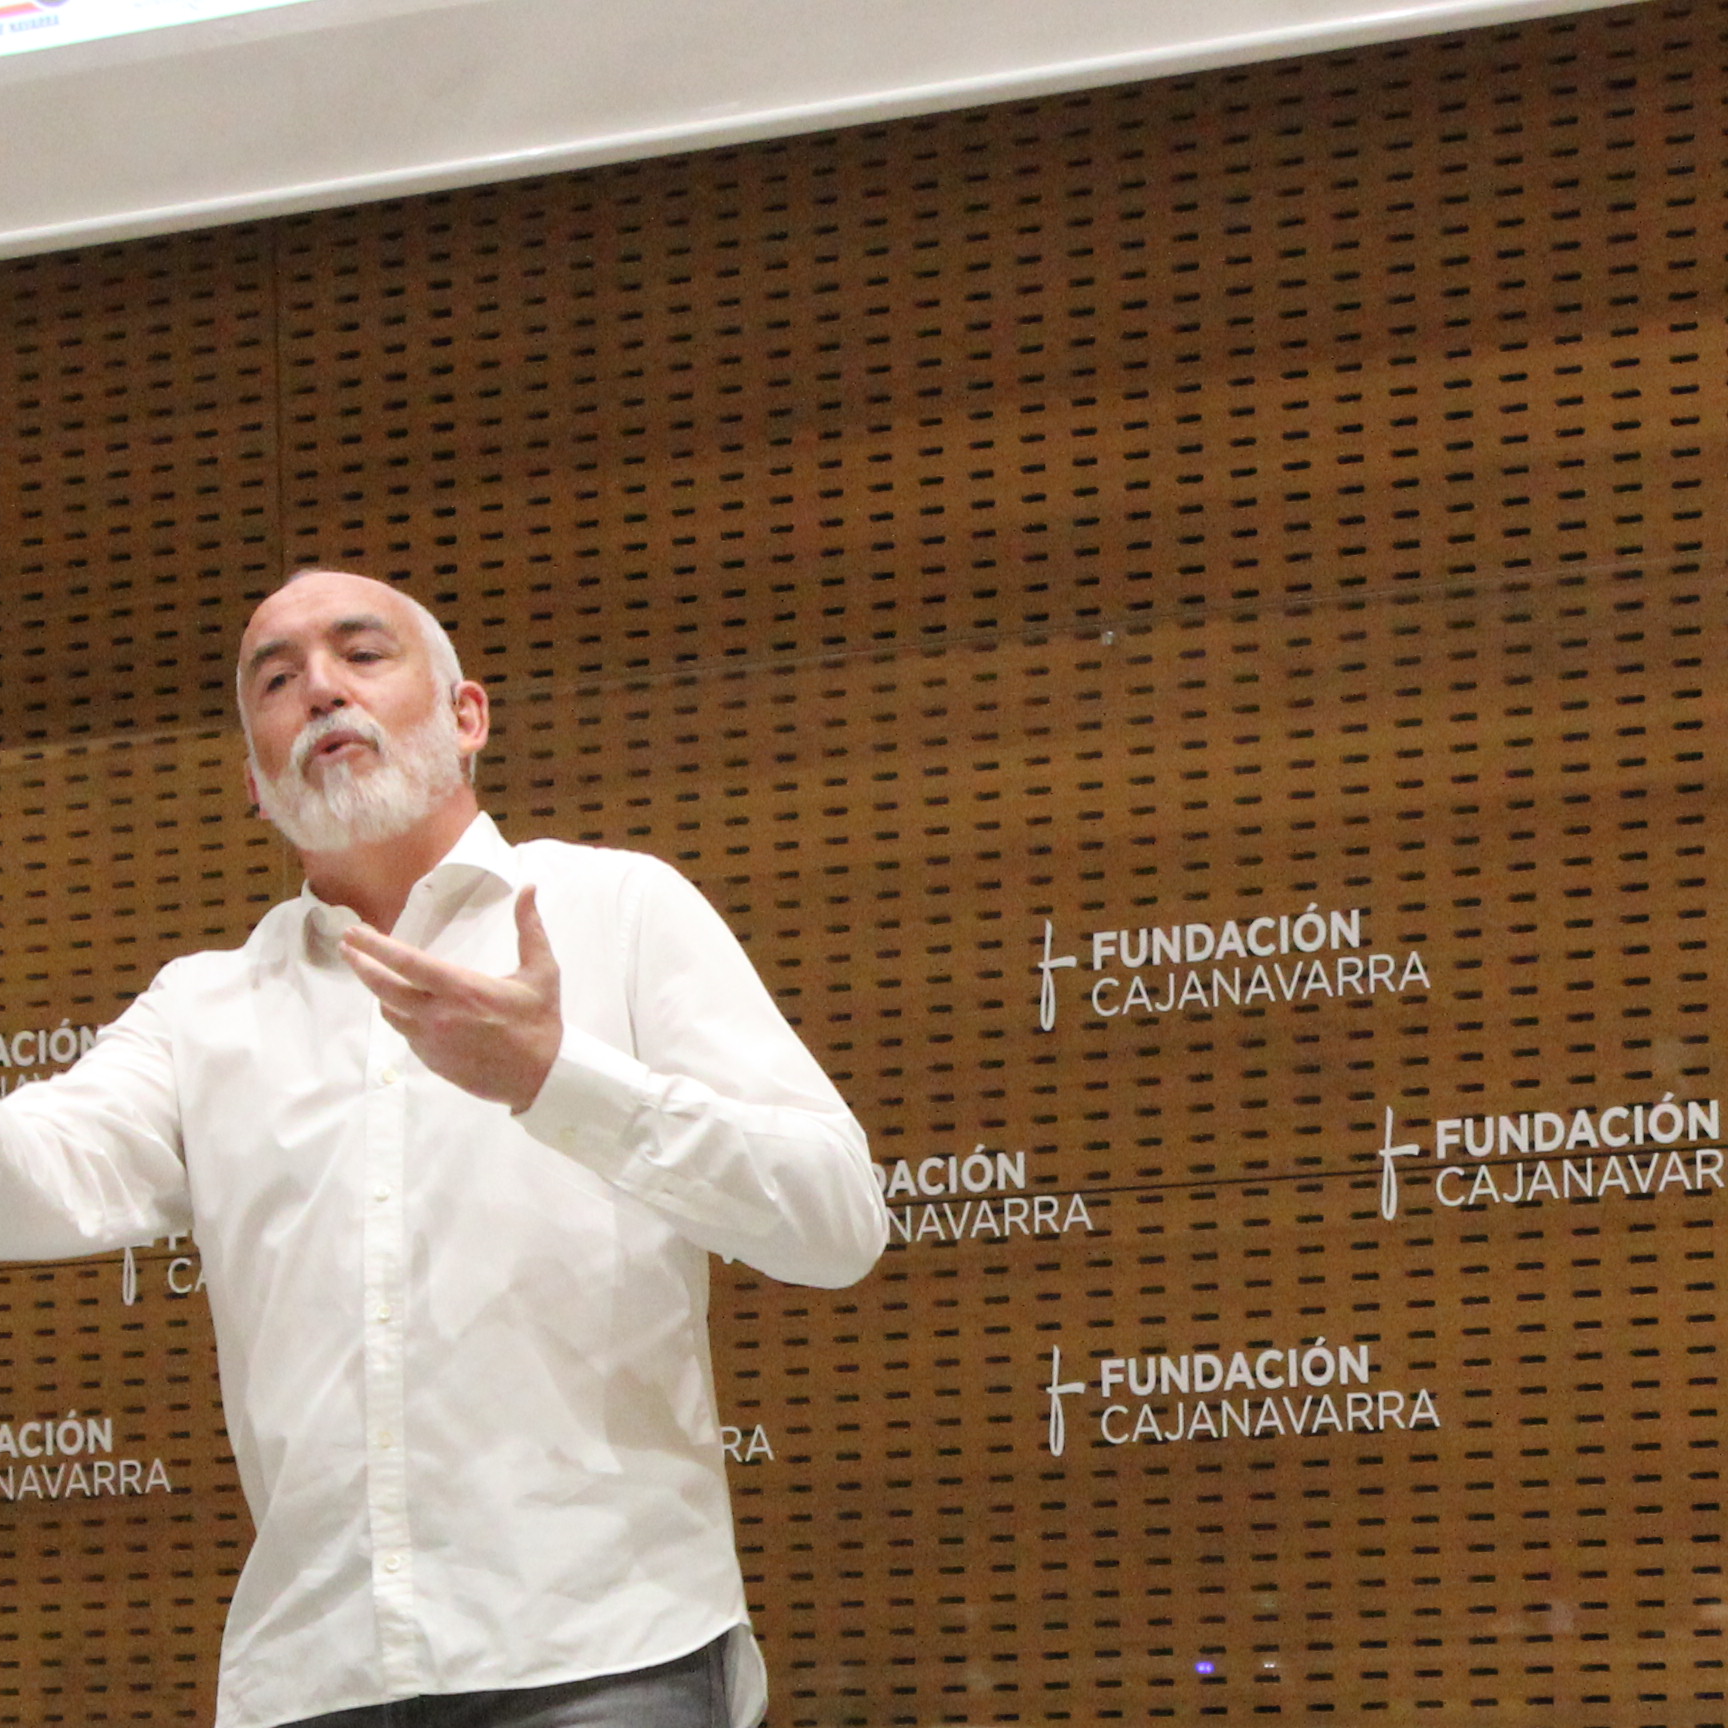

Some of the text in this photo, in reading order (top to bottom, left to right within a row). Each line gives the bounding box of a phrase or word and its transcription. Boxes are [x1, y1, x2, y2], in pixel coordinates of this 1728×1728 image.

[1093, 903, 1359, 970] FUNDACIÓN
[1092, 951, 1430, 1016] CAJANAVARRA
[1437, 1092, 1719, 1159] FUNDACIÓN
[886, 1193, 1094, 1243] NAVARRA
[1101, 1337, 1368, 1397] FUNDACIÓN
[1101, 1389, 1440, 1443] CAJANAVARRA
